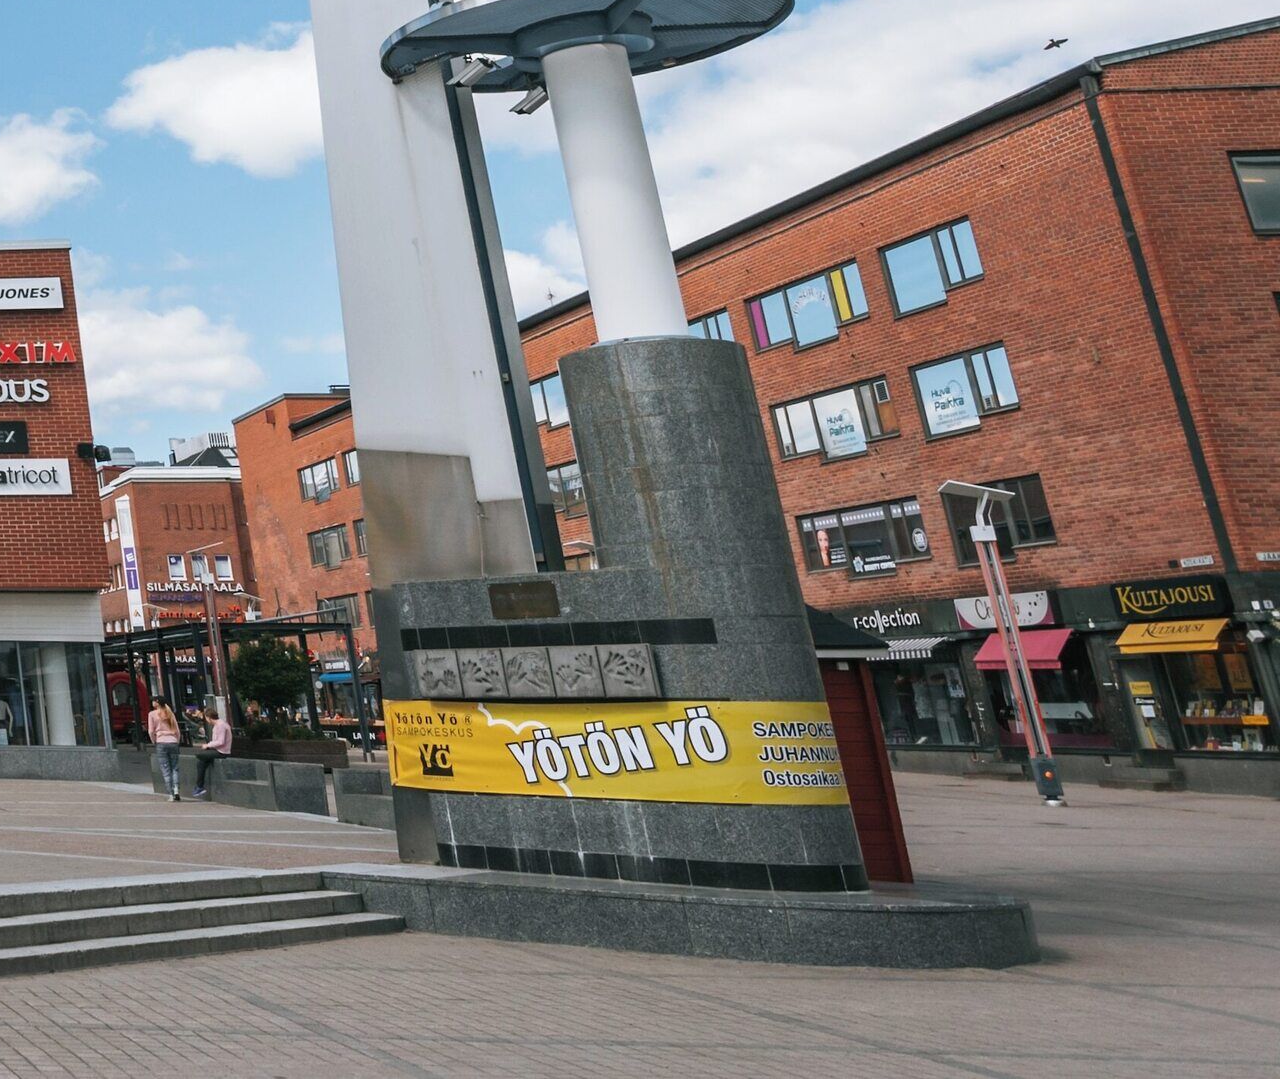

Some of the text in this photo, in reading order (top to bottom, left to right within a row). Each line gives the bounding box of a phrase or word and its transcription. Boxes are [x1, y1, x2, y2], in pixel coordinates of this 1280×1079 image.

[934, 395, 965, 412] Paikka
[1115, 584, 1216, 615] KULTAJOUSI
[853, 608, 921, 634] r-collection
[1141, 622, 1205, 639] KULTAJOUSI
[395, 712, 433, 725] Yötön
[437, 713, 458, 725] Yö
[397, 726, 474, 738] SAMPOKESKUS
[506, 705, 729, 785] YÖTÖN YÖ
